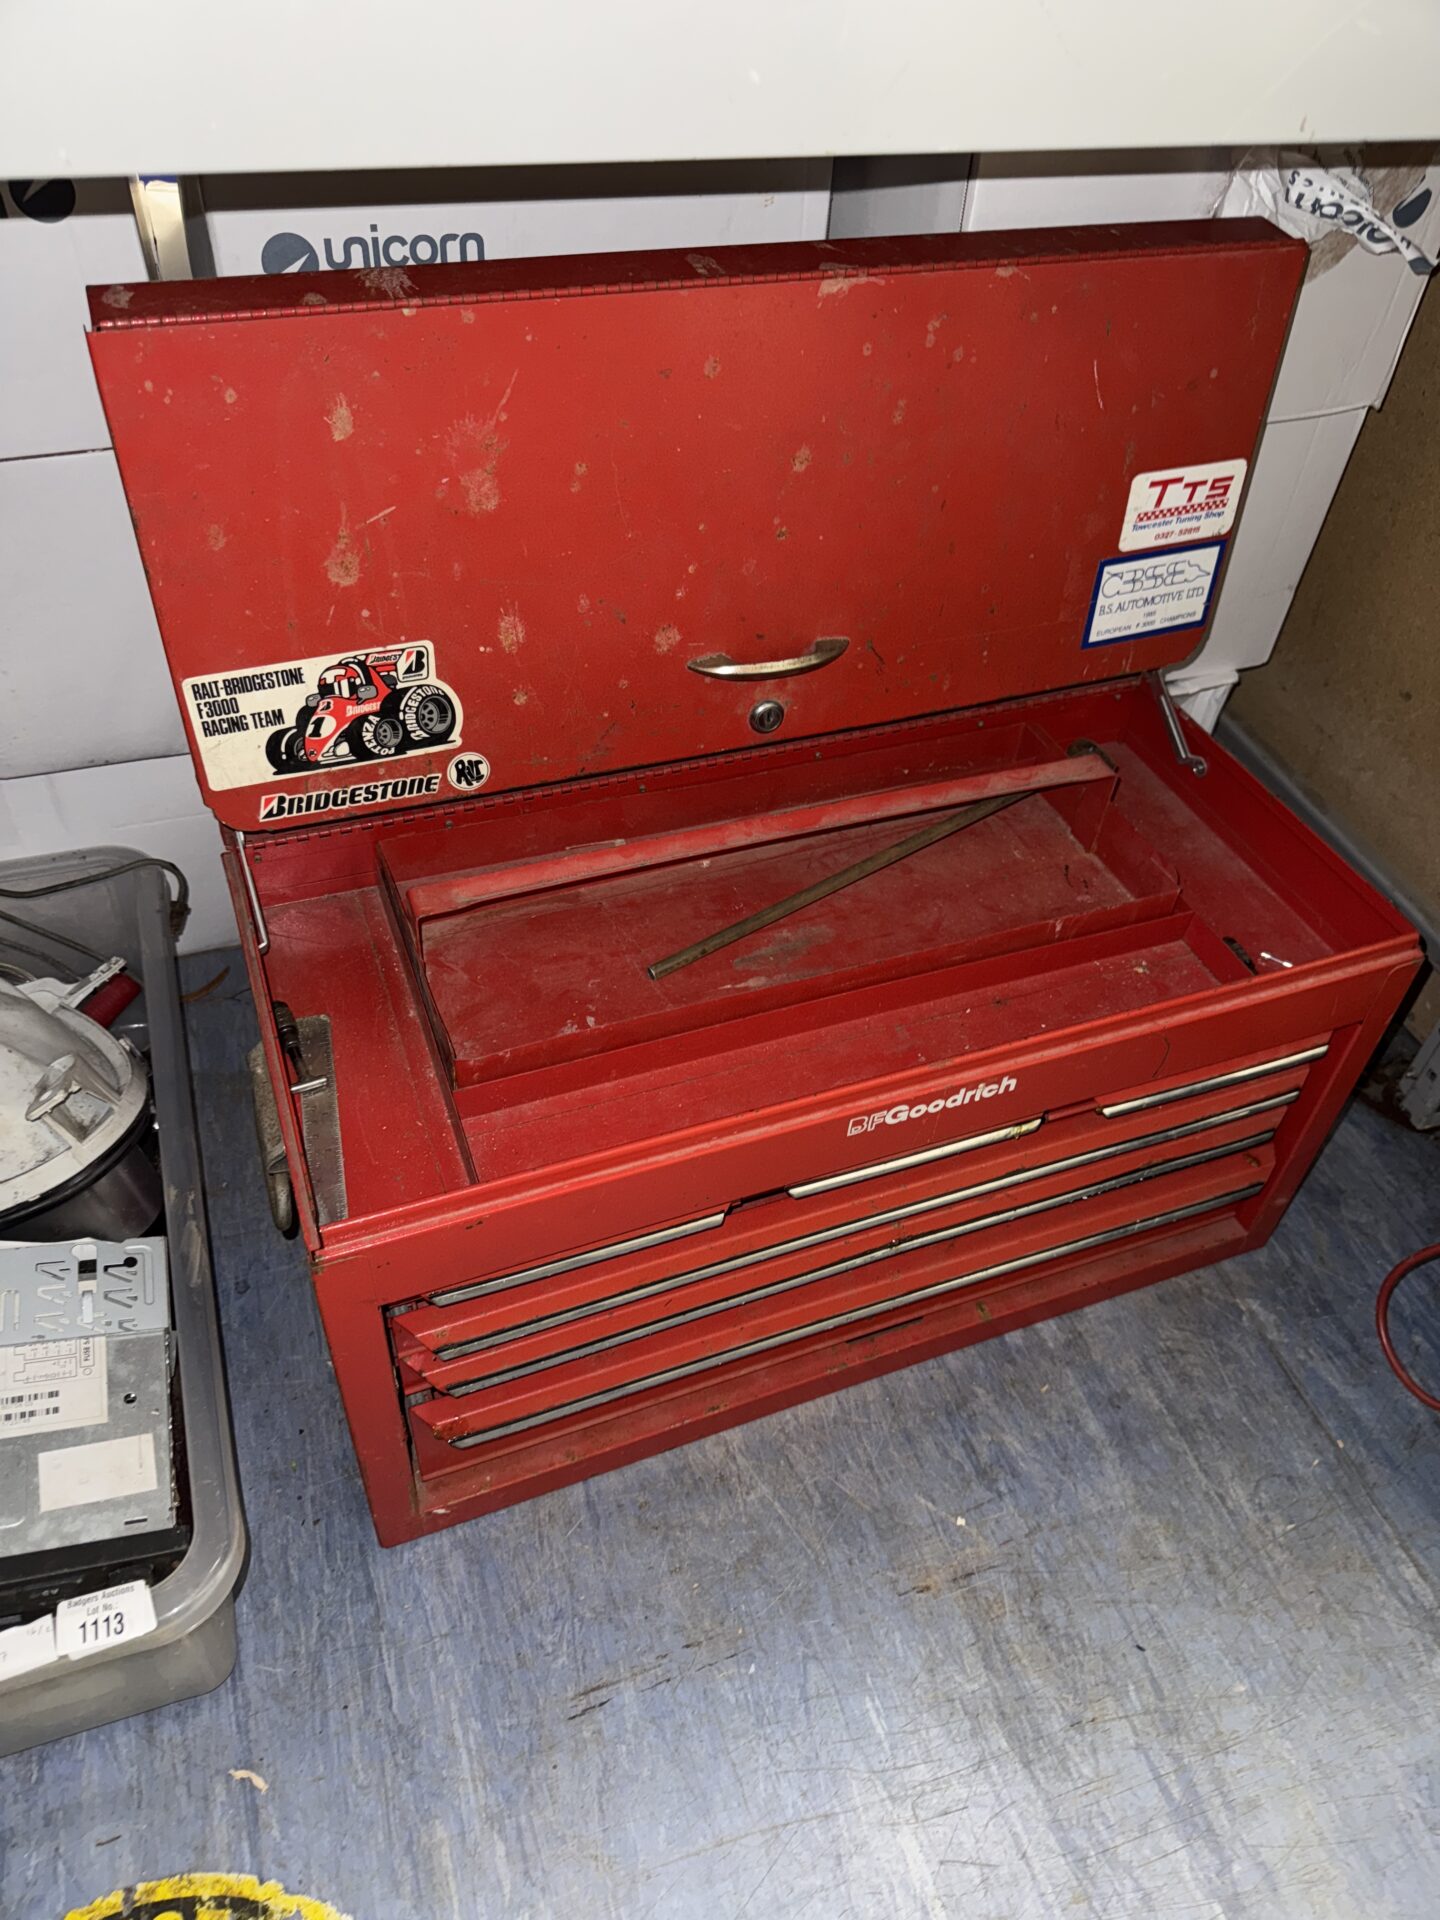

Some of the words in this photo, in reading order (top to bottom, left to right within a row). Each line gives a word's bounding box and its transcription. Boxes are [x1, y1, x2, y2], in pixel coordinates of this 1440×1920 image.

[323, 224, 486, 271] unicorn
[1149, 475, 1235, 509] TTS
[1176, 514, 1202, 525] Tuning
[1203, 510, 1225, 520] Shop
[1115, 590, 1185, 613] AUTOMOTIVE
[1096, 624, 1132, 637] EUROPEAN
[1160, 611, 1197, 624] CHAMPIONS
[191, 667, 306, 701] RALT-BRIDGESTONE
[196, 697, 240, 720] F3000
[201, 714, 249, 738] RACING
[252, 708, 286, 729] TEAM
[308, 716, 326, 738] 1
[361, 715, 396, 756] POTENZA
[260, 775, 440, 821] BRIDGESTONE
[847, 1076, 1018, 1137] BFGoodrich
[66, 1594, 99, 1610] Badgers
[100, 1585, 135, 1601] Auctions
[86, 1606, 100, 1617] Lot
[79, 1612, 125, 1644] 1113
